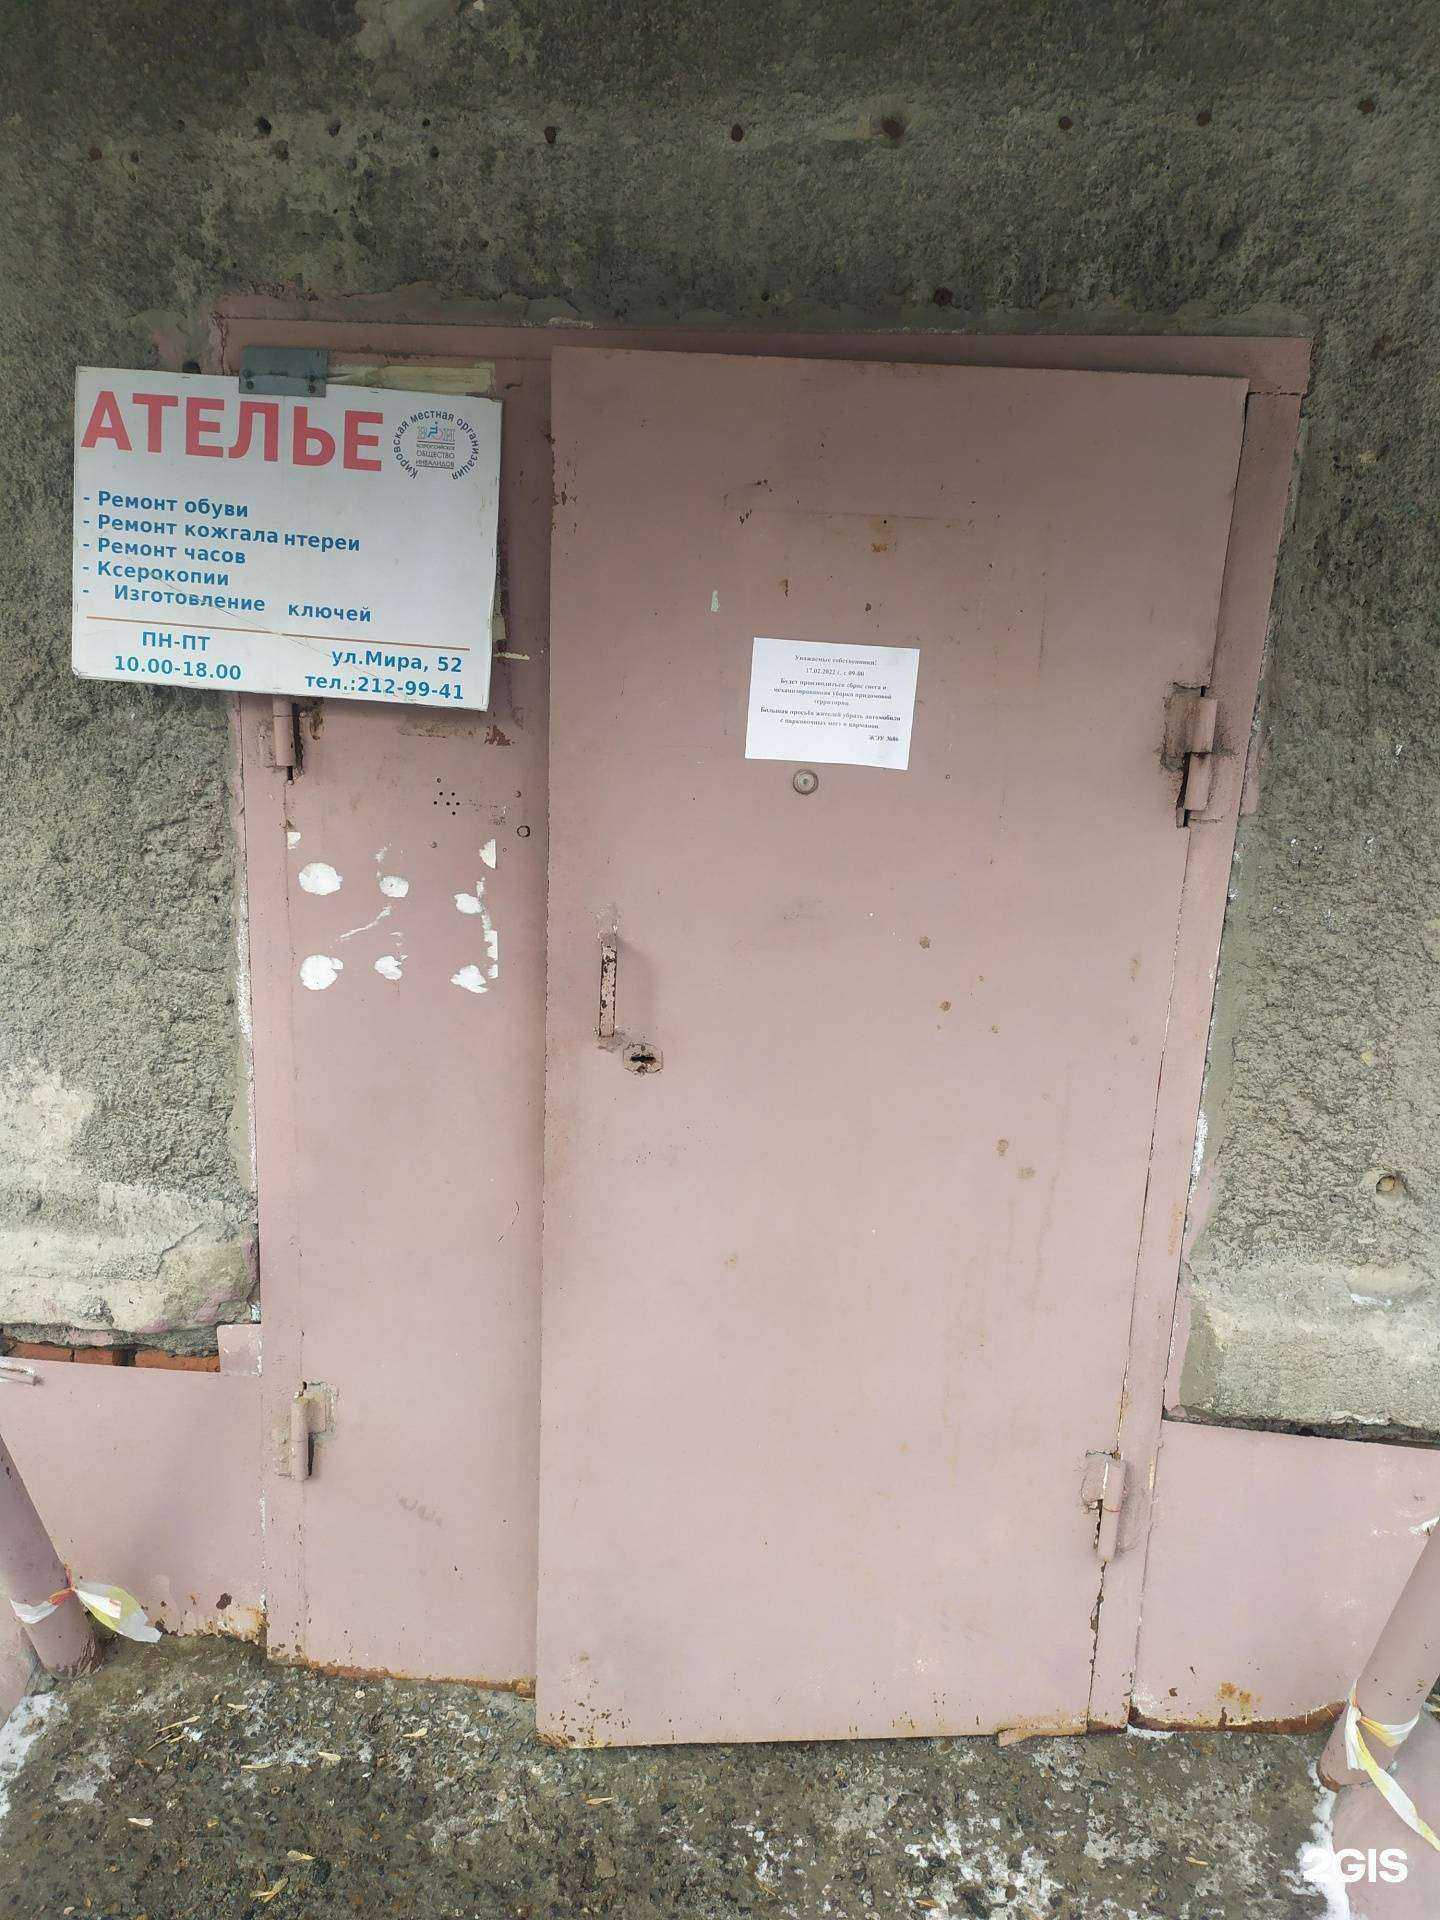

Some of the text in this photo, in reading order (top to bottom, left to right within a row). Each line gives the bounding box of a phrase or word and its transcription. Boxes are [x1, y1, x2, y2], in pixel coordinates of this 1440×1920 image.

[81, 391, 384, 472] АТЕЛЬЕ
[393, 410, 479, 480] Кировская местная организация
[416, 449, 455, 460] ОБЩЕСТВО
[415, 459, 455, 468] ИНВАЛИДОВ
[98, 490, 178, 512] Ремонт
[184, 498, 248, 519] обуви
[98, 514, 177, 535] Ремонт
[98, 537, 177, 558] Ремонт
[184, 547, 246, 564] часов
[97, 560, 229, 586] Ксерокопии
[114, 584, 266, 612] Изготовление
[288, 604, 371, 622] ключей
[142, 631, 211, 651] ПН-ПТ
[115, 655, 241, 680] 10.00-18.00
[332, 650, 462, 673] ул.Мира, 52
[305, 675, 464, 699] тел.:212-99-41
